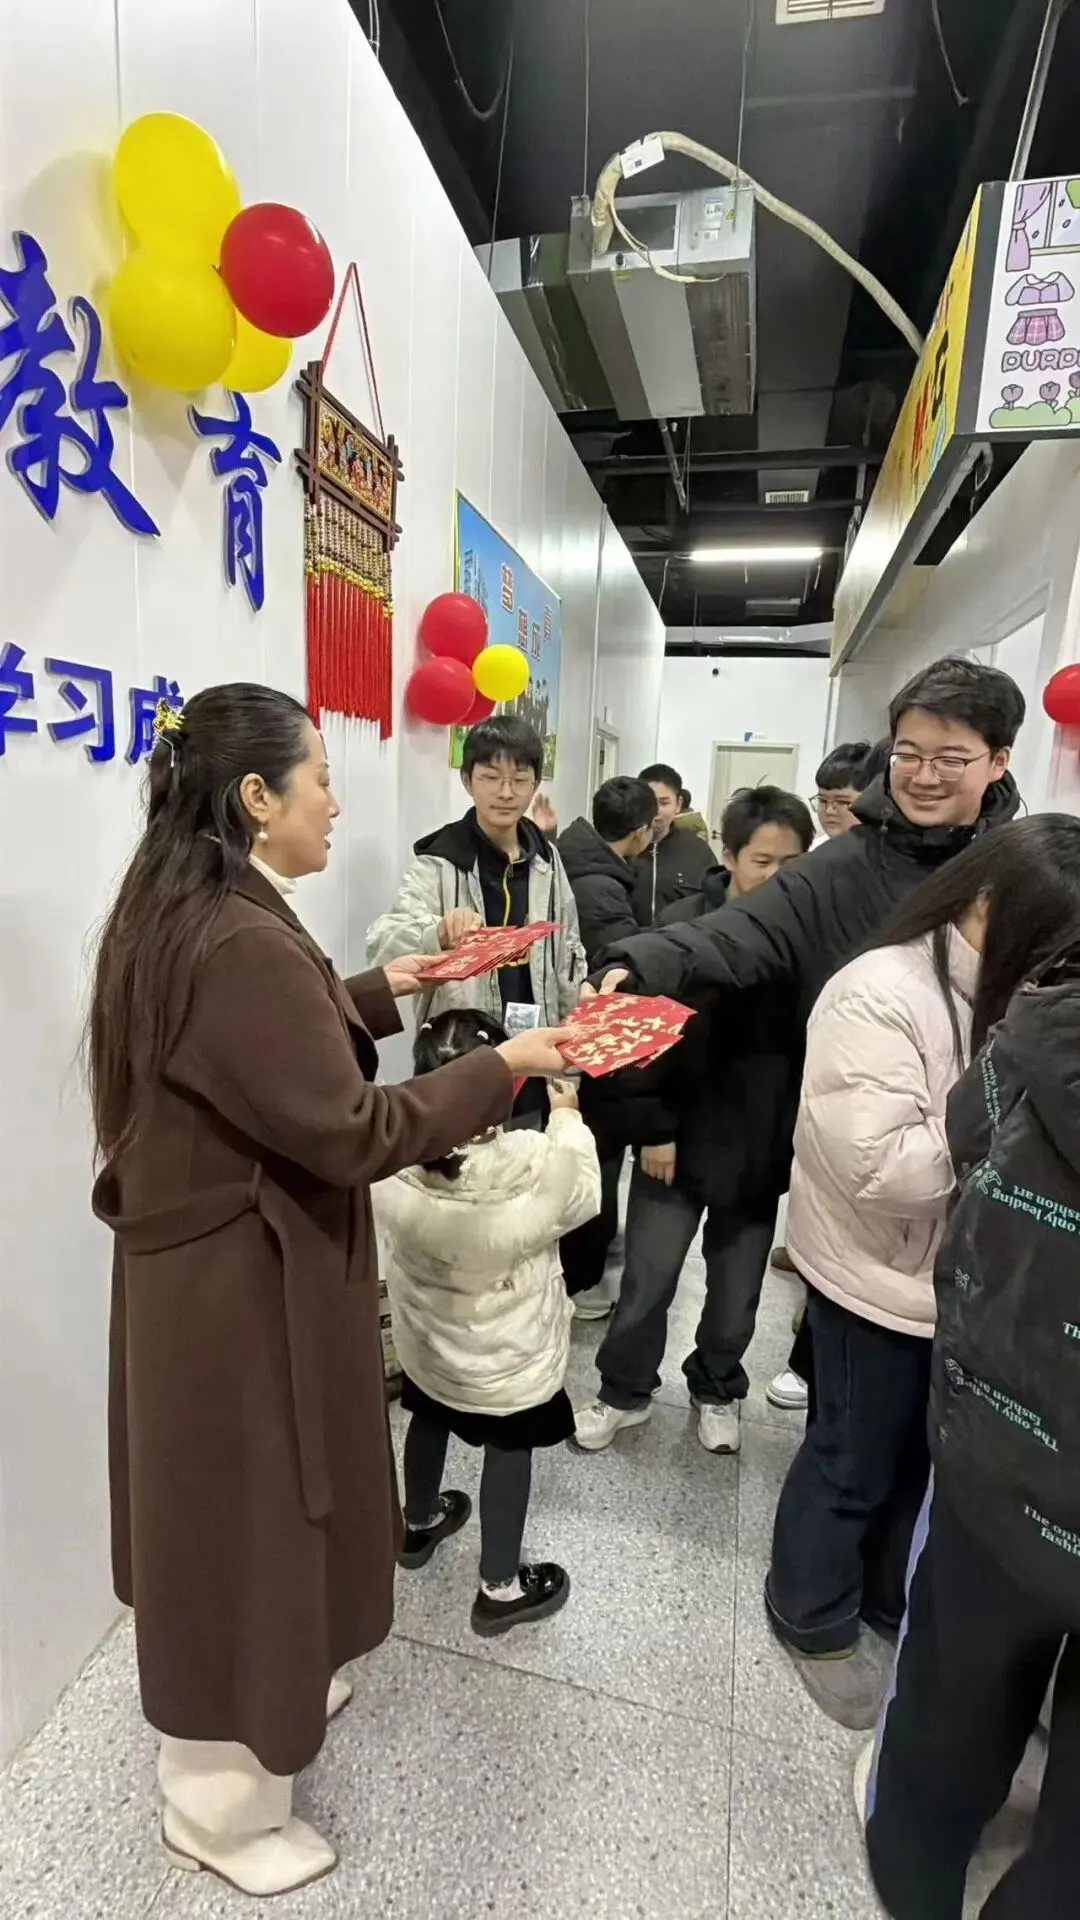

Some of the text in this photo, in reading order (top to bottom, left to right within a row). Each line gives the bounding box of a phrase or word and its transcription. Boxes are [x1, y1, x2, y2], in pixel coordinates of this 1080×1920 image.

[1001, 348, 1080, 373] PURP
[1012, 1185, 1034, 1201] art
[991, 1187, 1076, 1232] only leading
[992, 1389, 1041, 1427] fashion
[1033, 1427, 1059, 1453] The
[1023, 1503, 1050, 1527] The
